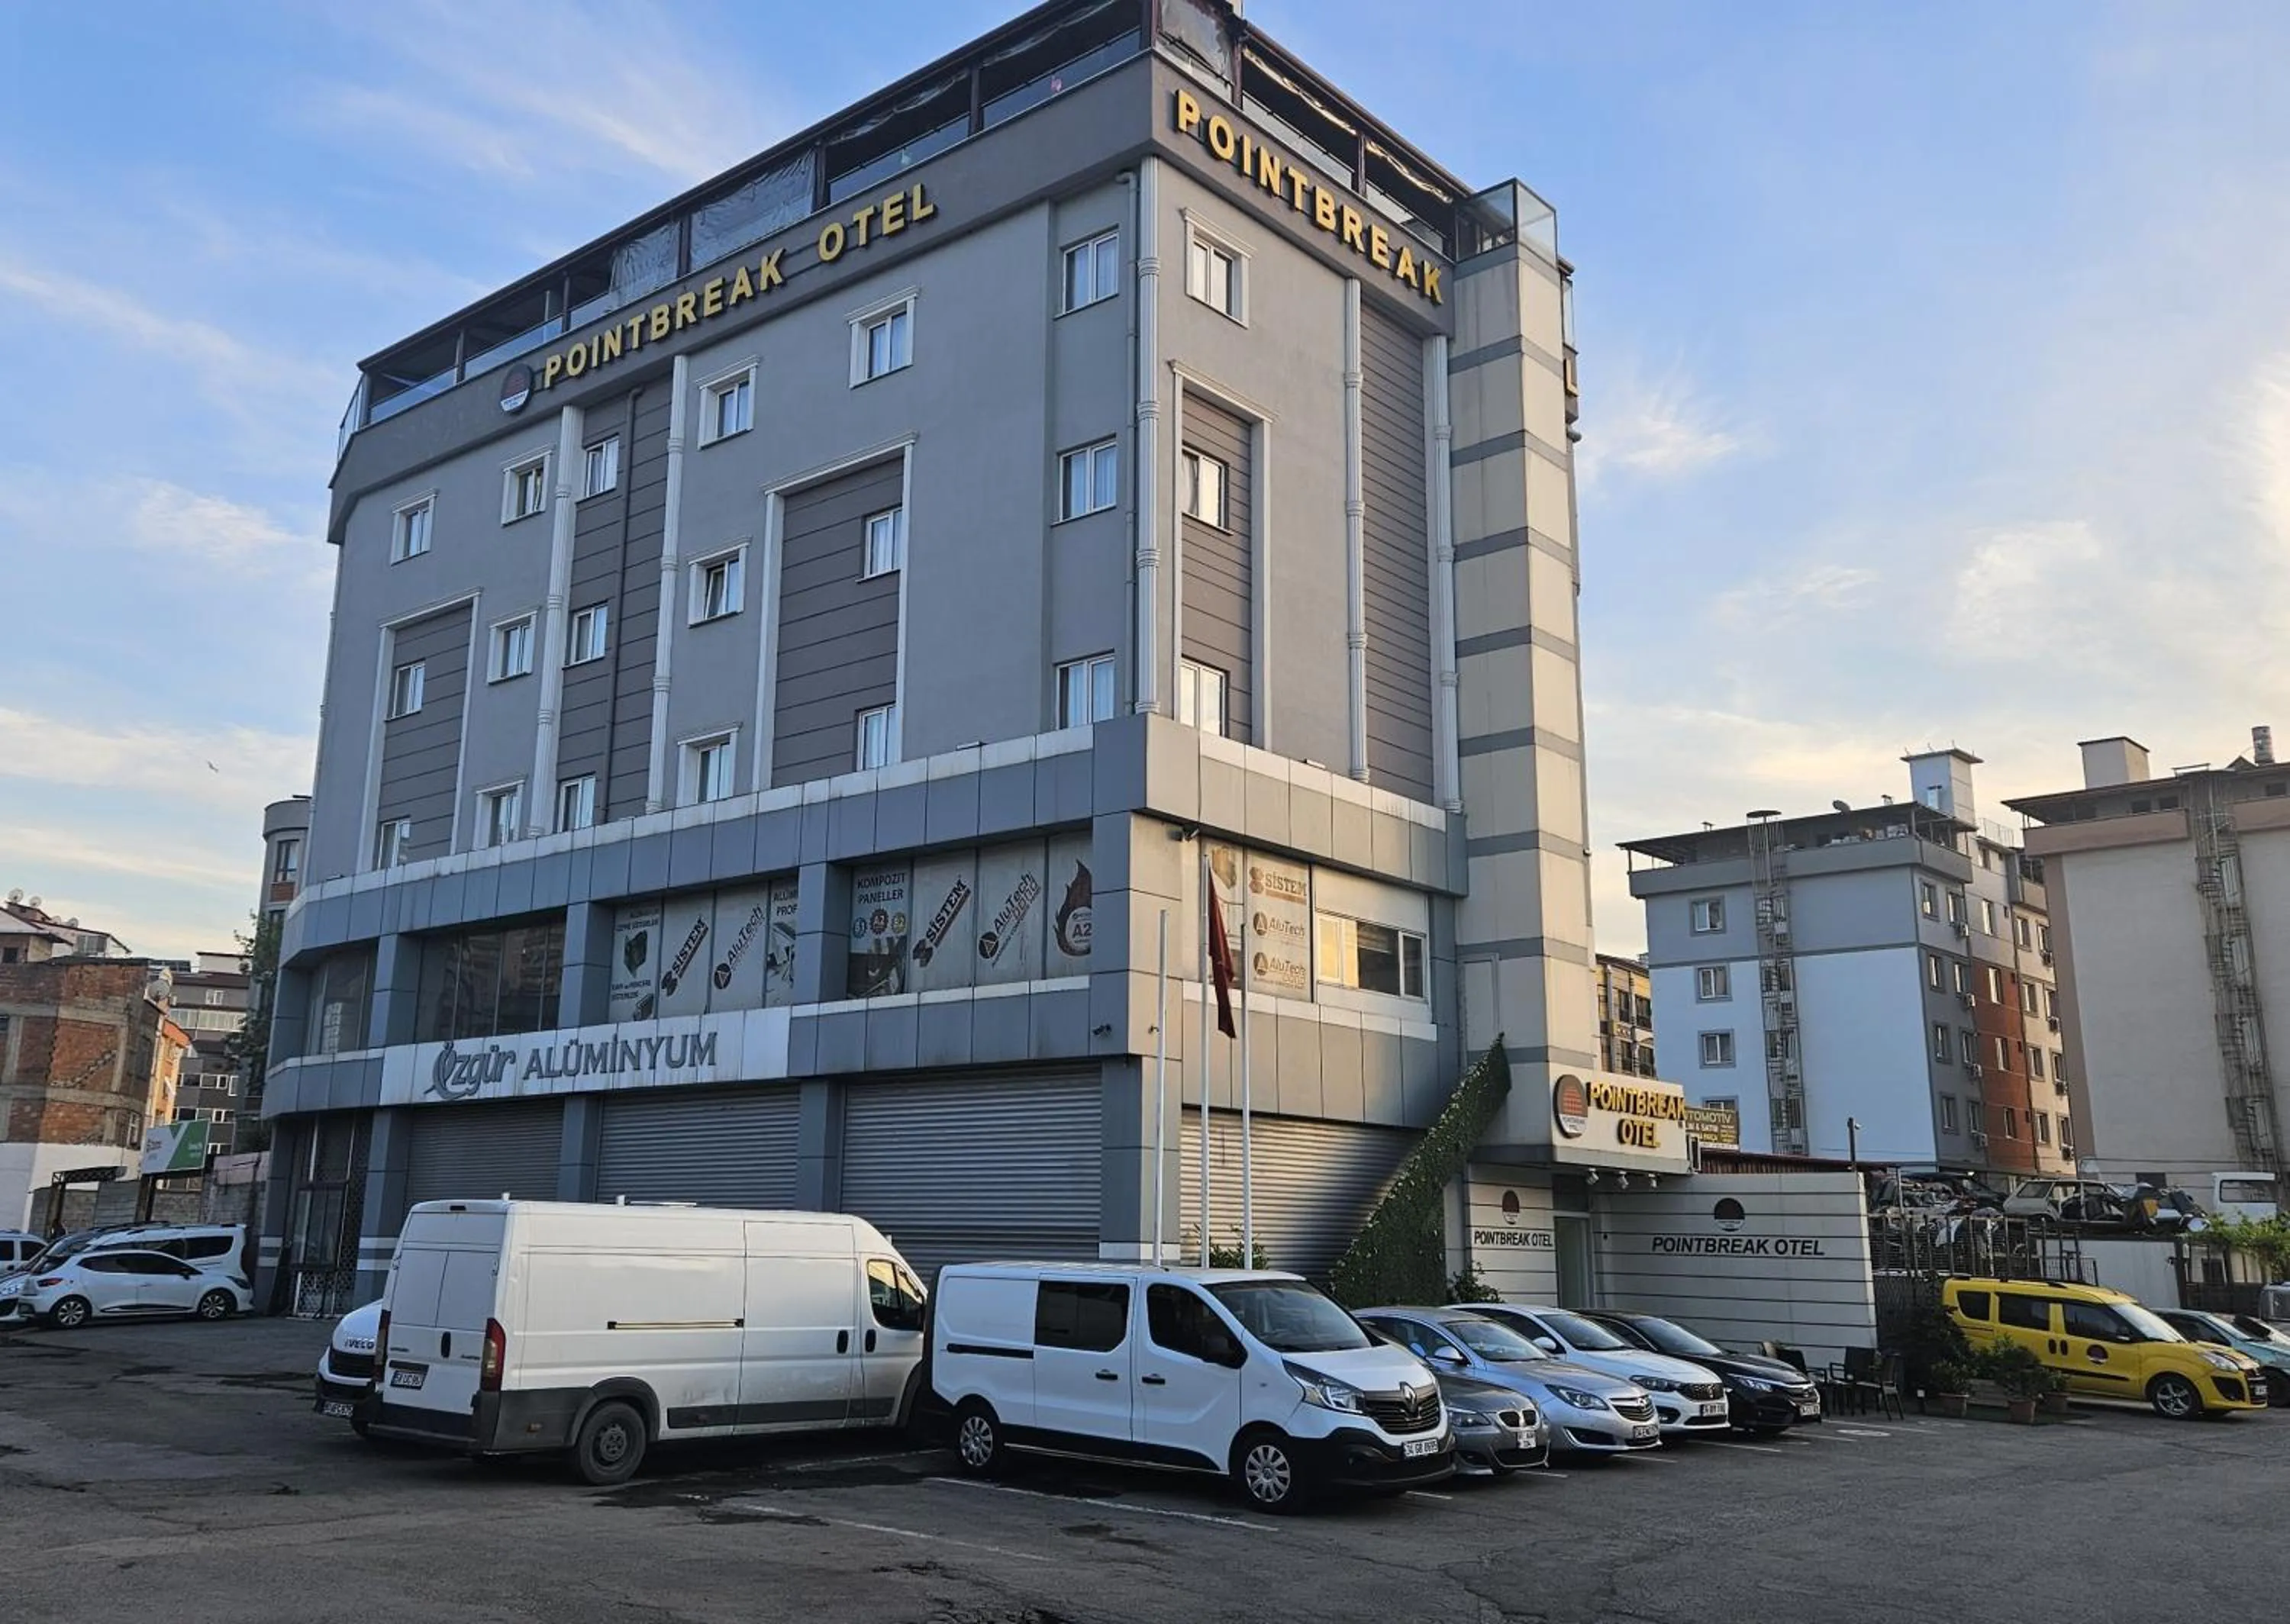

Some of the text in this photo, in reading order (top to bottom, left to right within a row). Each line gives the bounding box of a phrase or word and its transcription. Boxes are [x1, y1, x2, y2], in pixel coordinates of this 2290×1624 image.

[1176, 89, 1443, 304] POINTBREAK
[543, 182, 936, 389] POINTBREAK OTEL
[857, 888, 904, 904] PANELLER
[424, 1031, 718, 1100] Özgür ALÜMİNYUM
[1587, 1081, 1685, 1120] POINTBREAK
[1617, 1119, 1661, 1148] OTEL
[1474, 1230, 1553, 1247] POINTBREAK OTEL
[1652, 1236, 1824, 1256] POINTBREAK OTEL
[344, 1339, 375, 1350] IVECO
